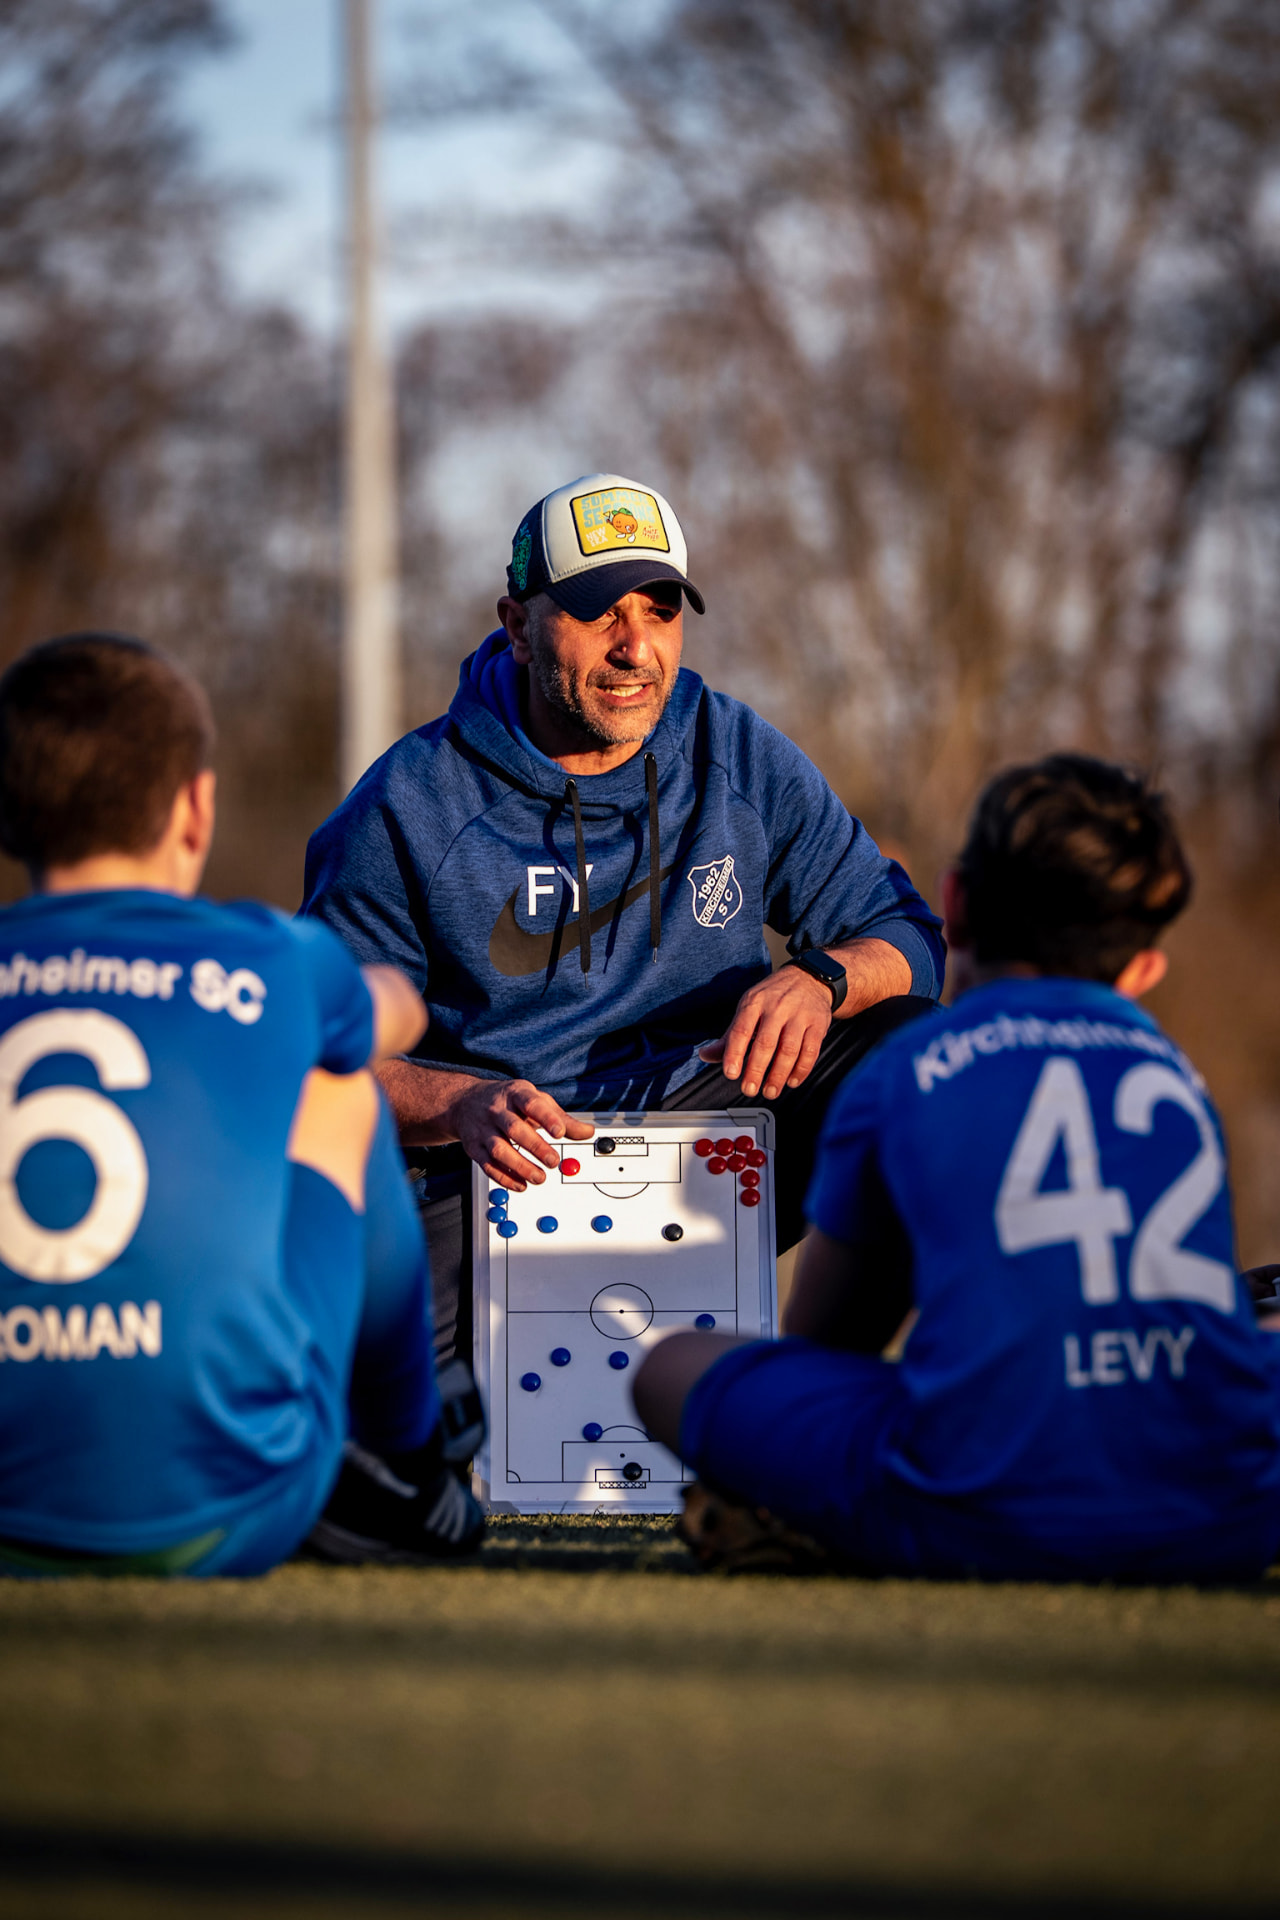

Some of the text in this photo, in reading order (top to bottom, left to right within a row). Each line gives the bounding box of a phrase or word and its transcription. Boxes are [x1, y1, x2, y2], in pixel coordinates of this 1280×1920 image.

[581, 491, 648, 509] SUMMER
[698, 867, 720, 900] 1962
[701, 857, 733, 924] KIRCHHEIMER
[190, 958, 267, 1025] SC
[0, 1008, 151, 1285] 6
[994, 1055, 1237, 1315] 42
[0, 1299, 162, 1363] OMAN
[1063, 1326, 1195, 1389] LEVY
